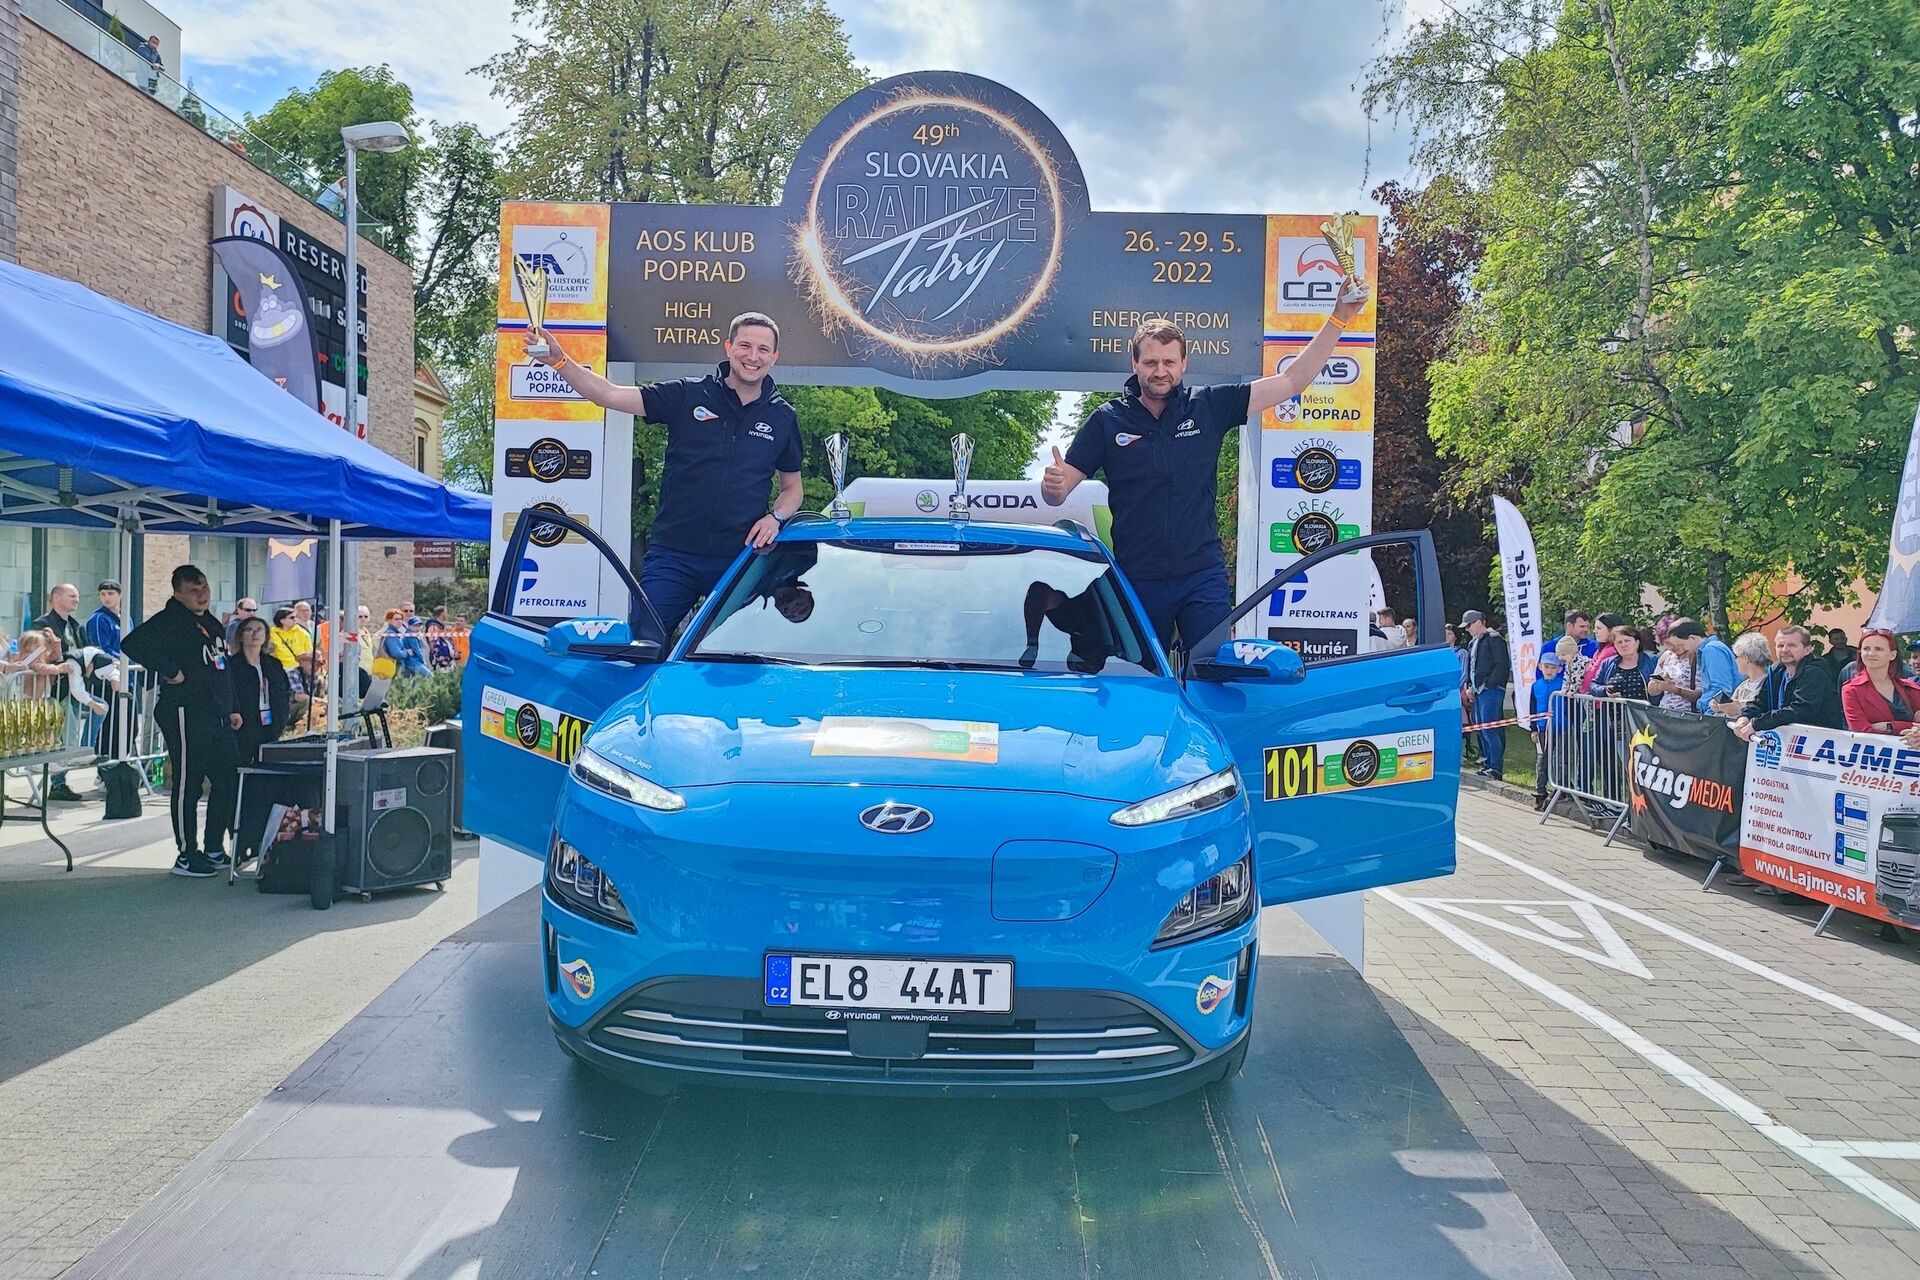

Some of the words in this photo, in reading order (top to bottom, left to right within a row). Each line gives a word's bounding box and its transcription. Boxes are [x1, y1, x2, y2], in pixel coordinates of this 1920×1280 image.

[912, 123, 960, 146] 49th
[865, 151, 1009, 179] SLOVAKIA
[834, 184, 1038, 242] RALLYE
[635, 229, 687, 252] AOS
[694, 231, 756, 253] KLUB
[842, 199, 1021, 321] Tatry
[643, 260, 747, 283] POPRAD
[1152, 261, 1213, 283] 2022
[664, 302, 712, 318] HIGH
[1174, 312, 1230, 329] FROM
[653, 328, 721, 345] TATRAS
[1090, 338, 1122, 353] THE
[526, 371, 549, 381] AOS
[1302, 394, 1335, 404] Mesto
[1302, 408, 1361, 420] POPRAD
[1290, 438, 1344, 457] HISTORIC
[1286, 498, 1345, 522] GREEN
[519, 597, 587, 608] PETROLTRANS
[1288, 609, 1358, 619] PETROLTRANS
[1303, 640, 1349, 655] kuriér
[485, 690, 507, 707] GREEN
[558, 715, 593, 764] 10
[1397, 733, 1430, 748] GREEN
[1267, 746, 1313, 799] 101
[1756, 777, 1790, 791] LOGISTIKA
[1839, 769, 1904, 794] slovakia
[1754, 791, 1785, 804] DOPRAVA
[1776, 825, 1813, 841] KONTROLY
[1751, 833, 1784, 849] KONTROLA
[1785, 843, 1832, 862] ORIGINALITY
[1754, 858, 1867, 905] www.Lajmex.sk
[800, 963, 868, 1001] EL8
[900, 966, 993, 1005] 44AT
[771, 987, 788, 999] CZ
[843, 1012, 881, 1020] HYUNDAI
[890, 1012, 949, 1022] www.hyundai.cz
